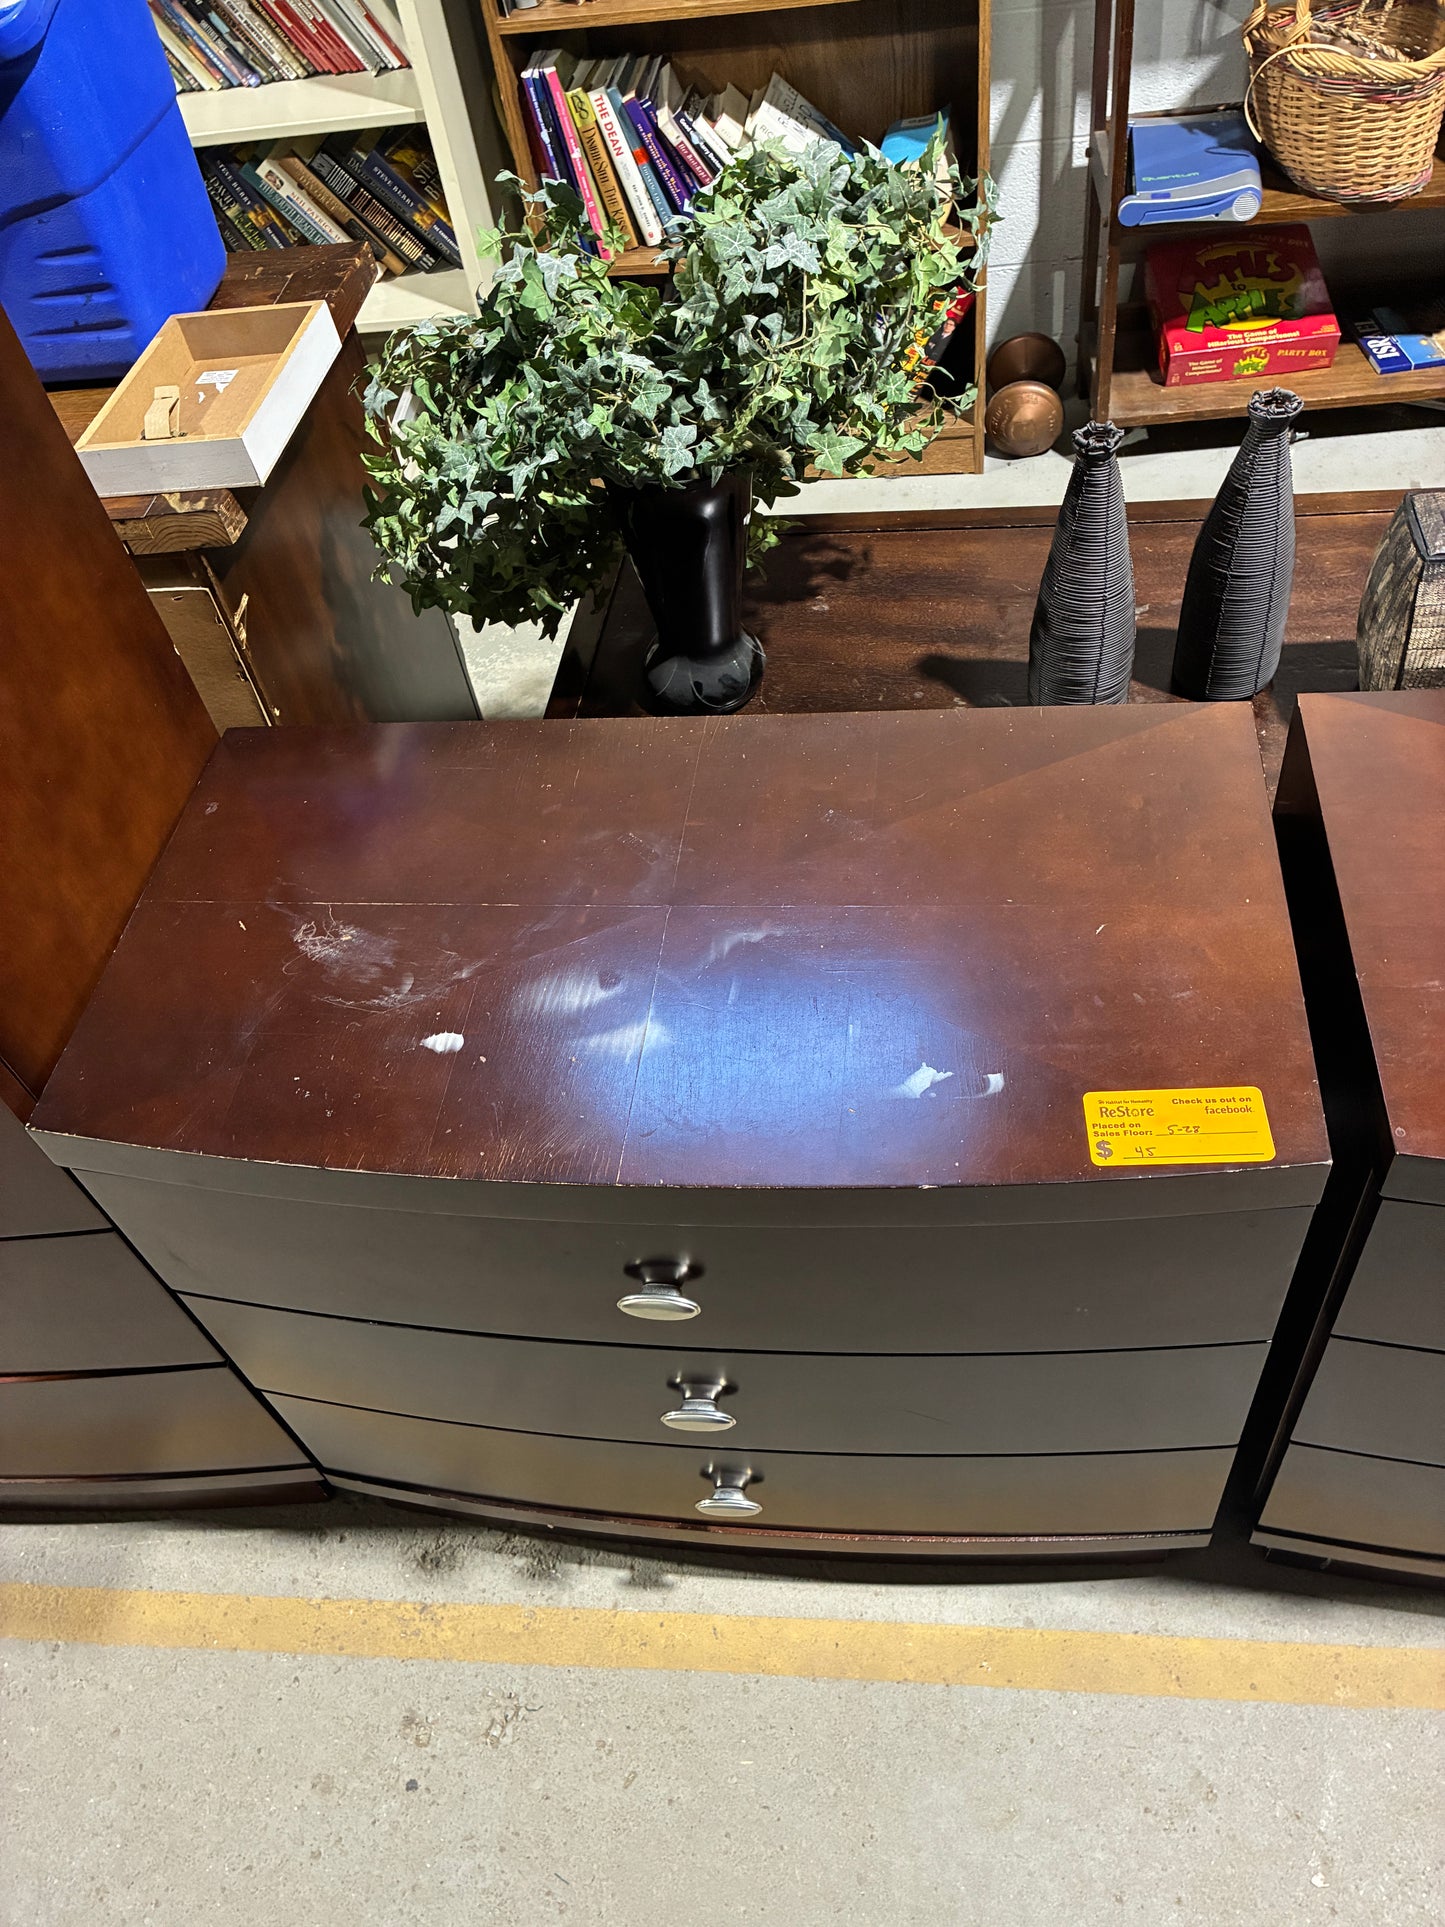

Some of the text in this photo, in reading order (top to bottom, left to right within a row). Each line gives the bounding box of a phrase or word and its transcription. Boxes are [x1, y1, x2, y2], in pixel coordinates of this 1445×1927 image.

[592, 94, 624, 157] THE DEAN
[678, 116, 692, 132] Good
[677, 142, 689, 155] Her
[658, 156, 668, 168] with
[664, 167, 672, 177] the
[371, 165, 394, 187] STEVE
[391, 184, 416, 208] BERRY
[1142, 172, 1199, 182] Quantum
[207, 175, 239, 209] DAVID
[230, 181, 253, 205] BERRY
[602, 185, 621, 207] THE
[257, 179, 276, 198] THE
[271, 193, 298, 219] SOUTH
[293, 214, 317, 238] BEACH
[289, 191, 306, 207] NEIL
[305, 207, 334, 234] PATRICK
[609, 206, 629, 232] KISS
[394, 230, 426, 262] PROOF
[1177, 250, 1296, 295] APPLES
[1231, 282, 1246, 292] to
[1185, 288, 1307, 333] APPLES
[1207, 331, 1300, 349] Hilarious Comparisons!
[1227, 328, 1277, 341] The Game of
[1276, 349, 1328, 357] PARTY BOX
[1171, 1097, 1203, 1105] Check
[1204, 1105, 1252, 1115] facebook
[1099, 1105, 1155, 1118] ReStore
[1092, 1122, 1126, 1130] Placed
[1093, 1130, 1121, 1138] Sales
[1123, 1129, 1153, 1137] Floor:
[1095, 1140, 1157, 1160] $ 45
